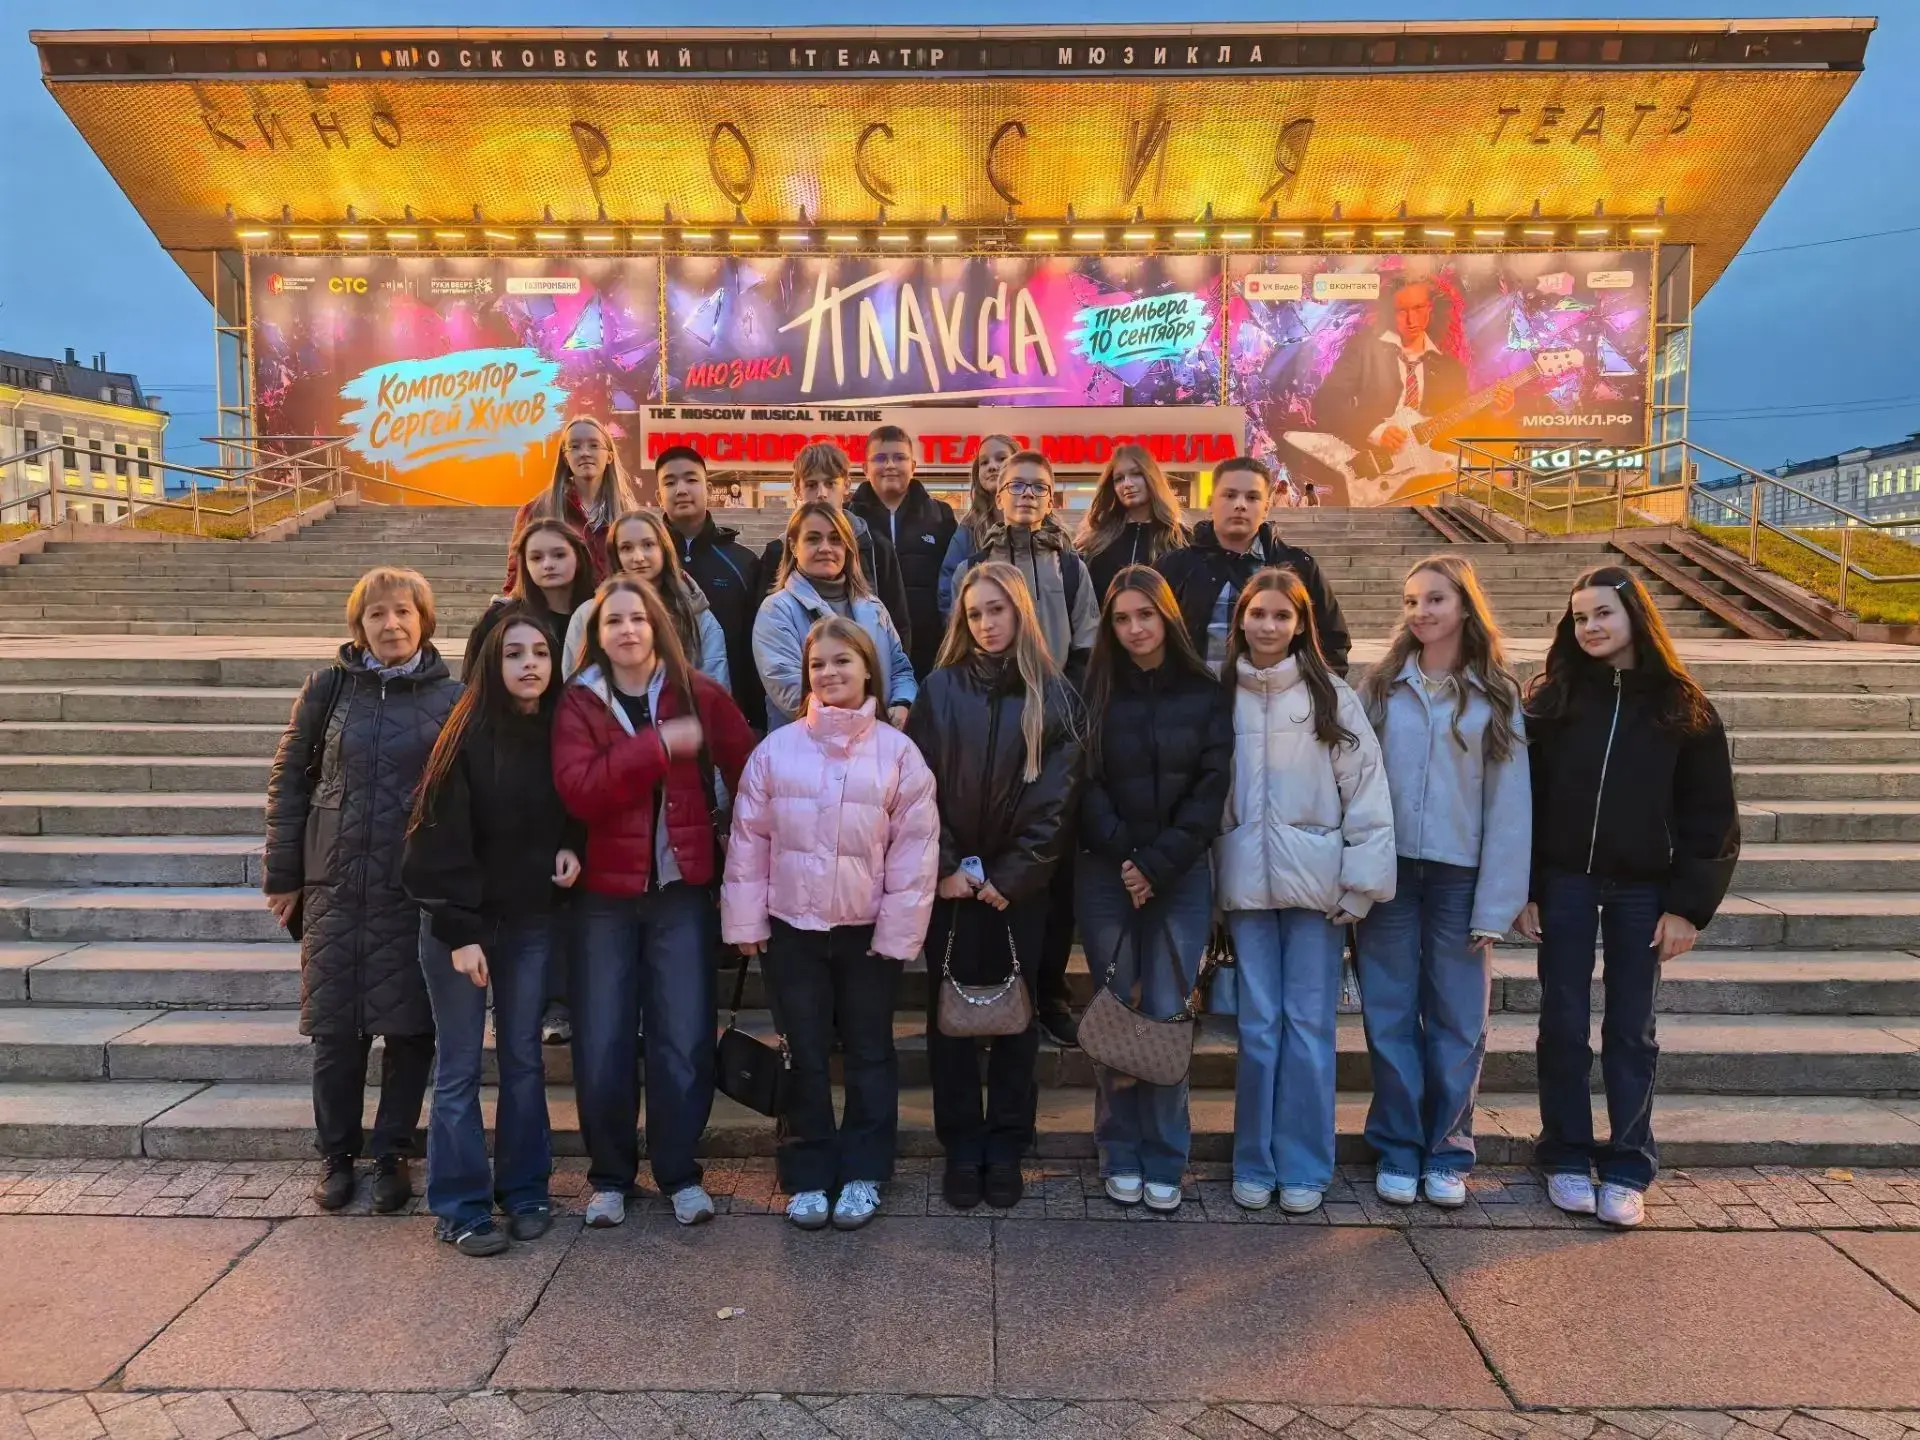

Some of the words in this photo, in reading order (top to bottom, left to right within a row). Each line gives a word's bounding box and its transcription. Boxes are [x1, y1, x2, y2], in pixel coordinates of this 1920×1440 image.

[396, 48, 691, 67] МОСКОВСКИЙ
[805, 48, 945, 67] ТЕАТР
[1058, 45, 1263, 65] МЮЗИКЛА
[201, 111, 402, 150] КИНО
[569, 118, 1316, 205] РОССИЯ
[1490, 104, 1693, 146] ТЕАТР
[328, 276, 368, 294] СТС
[525, 281, 577, 290] ГАЗПРОМБАНК
[778, 264, 1057, 393] ПЛАКСА
[1089, 329, 1113, 355] 10
[1117, 317, 1196, 348] сентября
[649, 408, 676, 420] THE
[681, 408, 746, 421] MOSCOW
[751, 409, 813, 421] MUSICAL
[819, 409, 882, 422] THEATRE
[1522, 414, 1633, 427] МЮЗИКЛ.РФ
